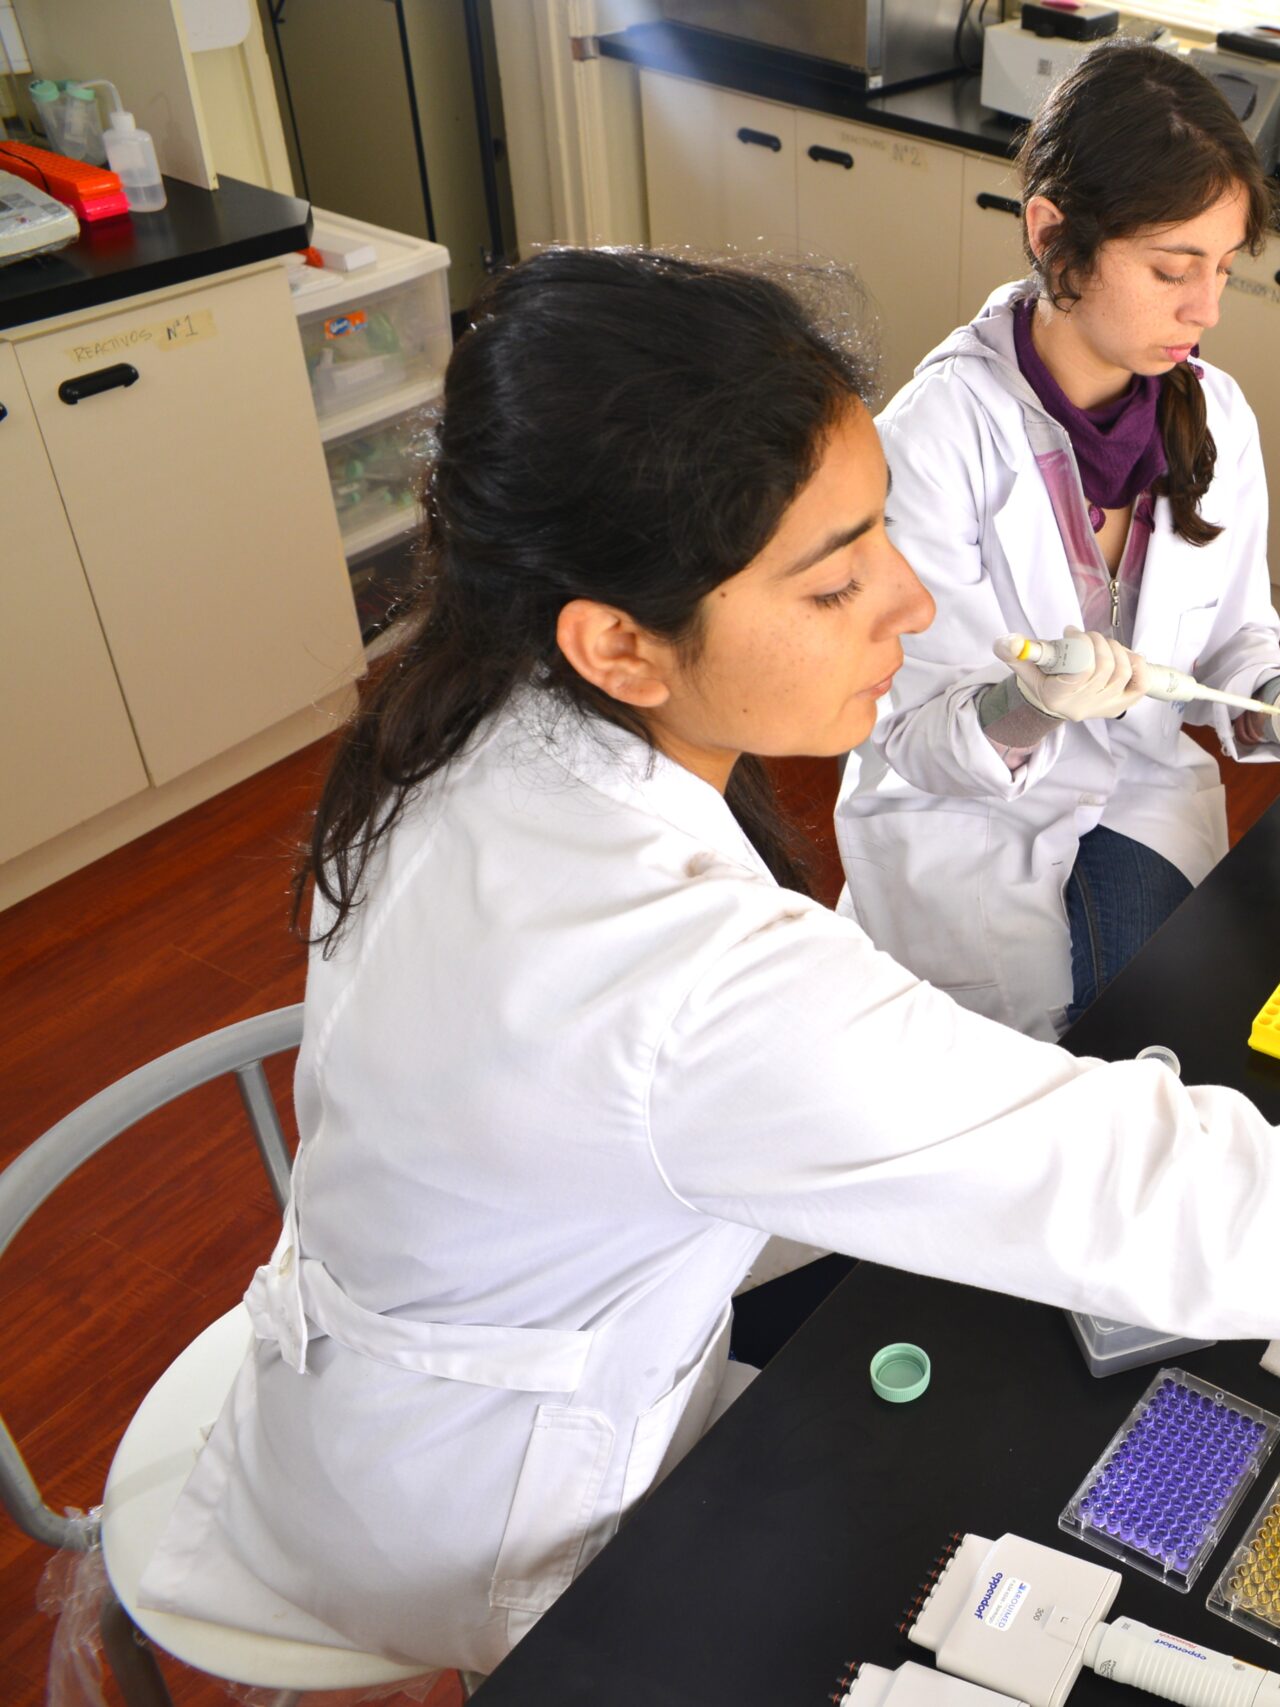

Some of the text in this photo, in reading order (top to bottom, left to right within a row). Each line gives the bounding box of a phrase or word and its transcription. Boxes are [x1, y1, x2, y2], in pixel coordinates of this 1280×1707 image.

[73, 328, 153, 363] REACTIVOS
[974, 1572, 1004, 1620] eppendorf
[1154, 1638, 1208, 1661] eppendorf
[1159, 1632, 1197, 1649] Research
